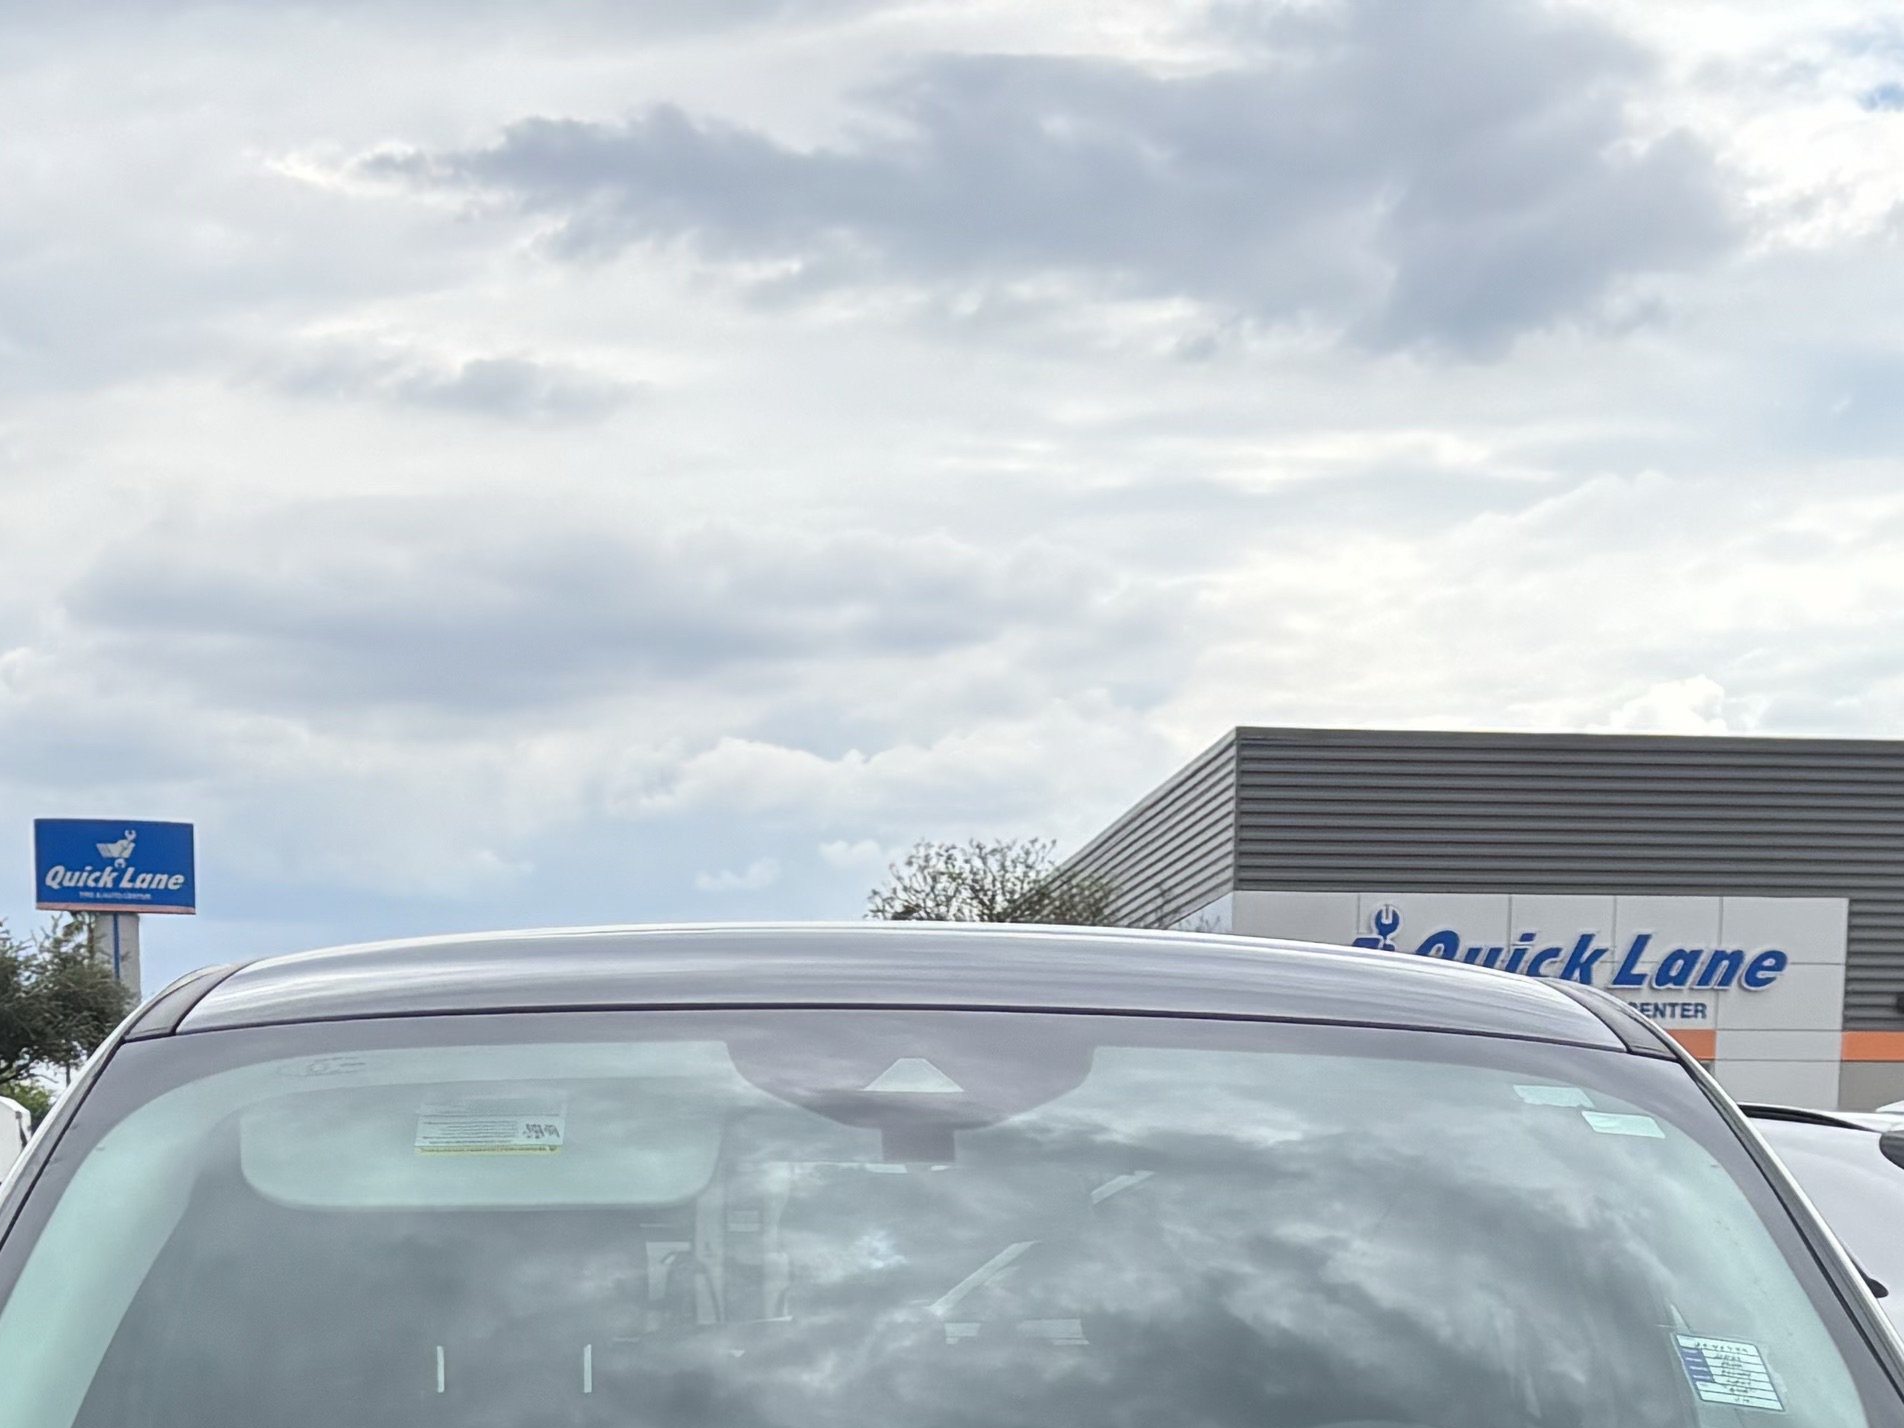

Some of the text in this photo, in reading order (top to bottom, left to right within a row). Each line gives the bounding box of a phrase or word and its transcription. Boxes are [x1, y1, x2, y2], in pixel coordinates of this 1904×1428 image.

[45, 864, 185, 890] Quick Lane
[1611, 933, 1788, 988] Lane
